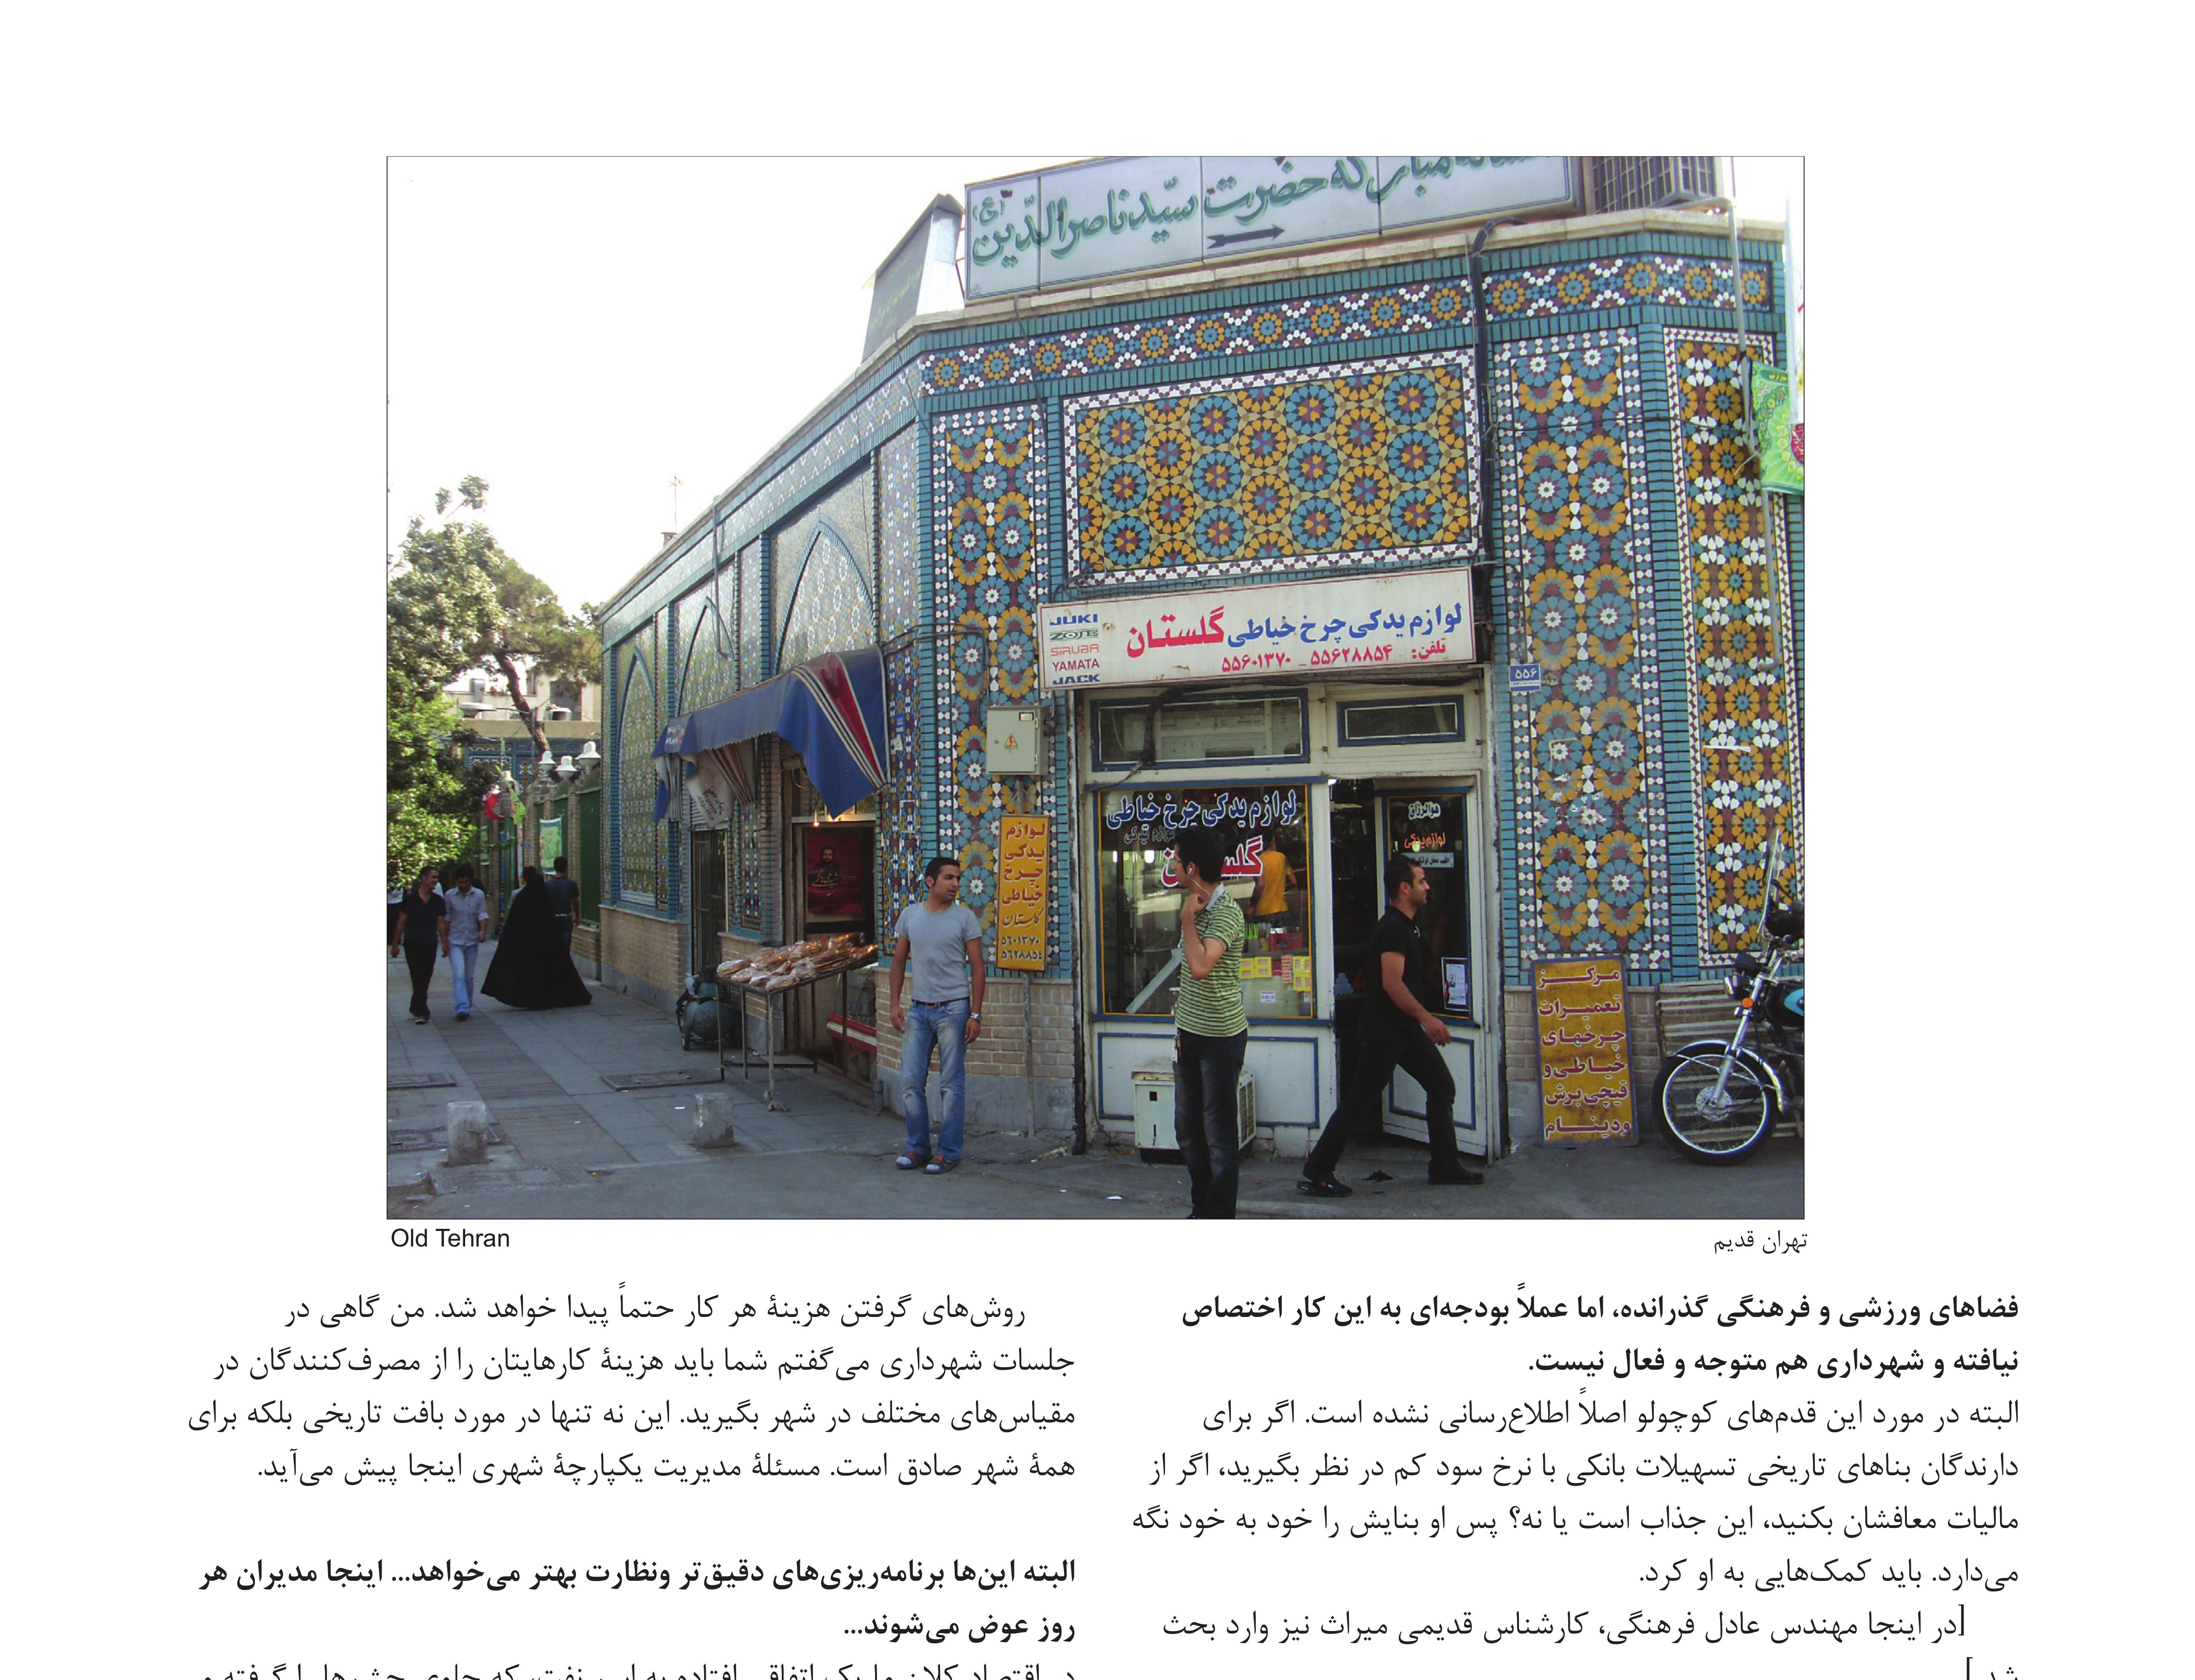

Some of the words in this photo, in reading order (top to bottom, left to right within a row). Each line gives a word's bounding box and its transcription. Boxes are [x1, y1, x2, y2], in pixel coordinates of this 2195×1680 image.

[1204, 161, 1328, 225] حضرت
[1050, 614, 1098, 626] JUKI
[1127, 605, 1224, 658] گلستان
[1228, 615, 1296, 648] خیاطی
[1300, 615, 1346, 643] چرخ
[1349, 608, 1405, 638] یدکی
[1409, 602, 1461, 638] لوازم
[1222, 652, 1291, 672] ۵۵۶۰۱۳۷۰
[1311, 644, 1393, 665] ۵۵۶۲۸۸۵۴
[1412, 638, 1445, 659] تلفن:
[1052, 658, 1100, 672] YAMATA
[1053, 674, 1100, 685] JACK
[1515, 668, 1536, 679] ۵۵۶
[1106, 793, 1160, 830] خیاطی
[1202, 793, 1247, 827] یدکی
[1249, 789, 1296, 828] لوازم
[1006, 822, 1046, 841] لوازم
[1425, 832, 1445, 847] لوازم
[1005, 843, 1045, 862] یدکی
[1003, 864, 1044, 886] چرخ
[1002, 885, 1043, 907] خیاطی
[1536, 966, 1620, 989] مرکز
[1538, 995, 1621, 1020] تعمیرات
[1553, 1054, 1626, 1079] خیاطی
[1545, 1084, 1582, 1107] برش
[1583, 1081, 1628, 1108] قیچی
[284, 1302, 309, 1327] در
[320, 1293, 380, 1328] گاهی
[435, 1297, 476, 1317] شد.
[488, 1294, 556, 1327] خواهد
[568, 1294, 609, 1328] پیدا
[619, 1281, 674, 1318] حتماً
[684, 1294, 719, 1327] کار
[728, 1303, 756, 1327] هر
[767, 1294, 830, 1327] هزینهٔ
[841, 1293, 912, 1327] گرفتن
[923, 1294, 1025, 1327] روش‌های
[1182, 1295, 1282, 1327] اختصاص
[1290, 1295, 1326, 1325] کار
[1334, 1295, 1371, 1327] این
[1380, 1301, 1401, 1325] به
[1410, 1295, 1509, 1326] بودجه‌ای
[1517, 1282, 1568, 1318] عملاً
[1577, 1295, 1604, 1318] اما
[1613, 1294, 1709, 1325] گذرانده،
[1717, 1294, 1810, 1327] فرهنگی
[1839, 1296, 1920, 1327] ورزشی
[1929, 1295, 2018, 1326] فضاهای
[391, 1304, 424, 1327] من
[1818, 1306, 1830, 1325] و
[1529, 1350, 1604, 1377] نیست.
[1613, 1347, 1664, 1379] فعال
[1673, 1358, 1685, 1378] و
[1694, 1354, 1767, 1379] متوجه
[1776, 1354, 1807, 1379] هم
[1817, 1348, 1924, 1379] شهرداری
[1932, 1358, 1944, 1378] و
[1954, 1347, 2018, 1377] نیافته
[1203, 1399, 1252, 1433] برای
[1261, 1399, 1294, 1433] اگر
[1306, 1399, 1362, 1423] است.
[1373, 1404, 1428, 1423] نشده
[1439, 1399, 1569, 1434] اطلاع‌رسانی
[1578, 1387, 1626, 1425] اصلاً
[1636, 1400, 1718, 1433] کوچولو
[1728, 1399, 1816, 1434] قدم‌های
[1827, 1399, 1862, 1433] این
[1873, 1408, 1924, 1433] مورد
[1933, 1408, 1959, 1433] در
[1970, 1399, 2018, 1430] البته
[258, 1448, 333, 1486] می‌آید.
[344, 1457, 397, 1486] پیش
[409, 1452, 461, 1483] اینجا
[473, 1455, 543, 1485] شهری
[554, 1452, 643, 1486] یکپارچهٔ
[654, 1459, 741, 1485] مدیریت
[752, 1452, 820, 1476] مسئلهٔ
[831, 1452, 887, 1476] است.
[898, 1452, 962, 1485] صادق
[971, 1455, 1018, 1485] شهر
[1030, 1452, 1075, 1477] همهٔ
[1149, 1452, 1165, 1485] از
[1175, 1452, 1209, 1485] اگر
[1219, 1452, 1299, 1485] بگیرید،
[1309, 1452, 1349, 1485] نظر
[1358, 1461, 1384, 1485] در
[1395, 1452, 1427, 1486] کم
[1437, 1461, 1482, 1485] سود
[1493, 1456, 1531, 1487] نرخ
[1542, 1452, 1555, 1483] با
[1566, 1452, 1625, 1486] بانکی
[1636, 1452, 1737, 1485] تسهیلات
[1748, 1452, 1826, 1486] تاریخی
[1838, 1452, 1910, 1484] بناهای
[1921, 1452, 2018, 1485] دارندگان
[198, 1565, 227, 1590] هر
[237, 1559, 317, 1591] مدیران
[327, 1559, 382, 1588] اینجا
[392, 1559, 520, 1591] می‌خواهد...
[528, 1565, 577, 1590] بهتر
[586, 1559, 670, 1589] ونظارت
[678, 1558, 764, 1590] دقیق‌تر
[773, 1559, 944, 1590] برنامه‌ریزی‌های
[954, 1559, 1015, 1591] این‌ها
[1024, 1559, 1075, 1589] البته
[844, 1613, 959, 1644] می‌شوند...
[968, 1614, 1029, 1643] عوض
[1037, 1617, 1075, 1642] روز
[1163, 1615, 1216, 1641] بحث
[1227, 1610, 1268, 1644] وارد
[1278, 1615, 1309, 1644] نیز
[1321, 1610, 1387, 1644] میراث
[1398, 1611, 1472, 1645] قدیمی
[1484, 1610, 1589, 1644] کارشناس
[1599, 1610, 1694, 1645] فرهنگی،
[1705, 1610, 1760, 1643] عادل
[1771, 1618, 1857, 1644] مهندس
[1869, 1610, 1921, 1641] اینجا
[1931, 1604, 1964, 1644] [در
